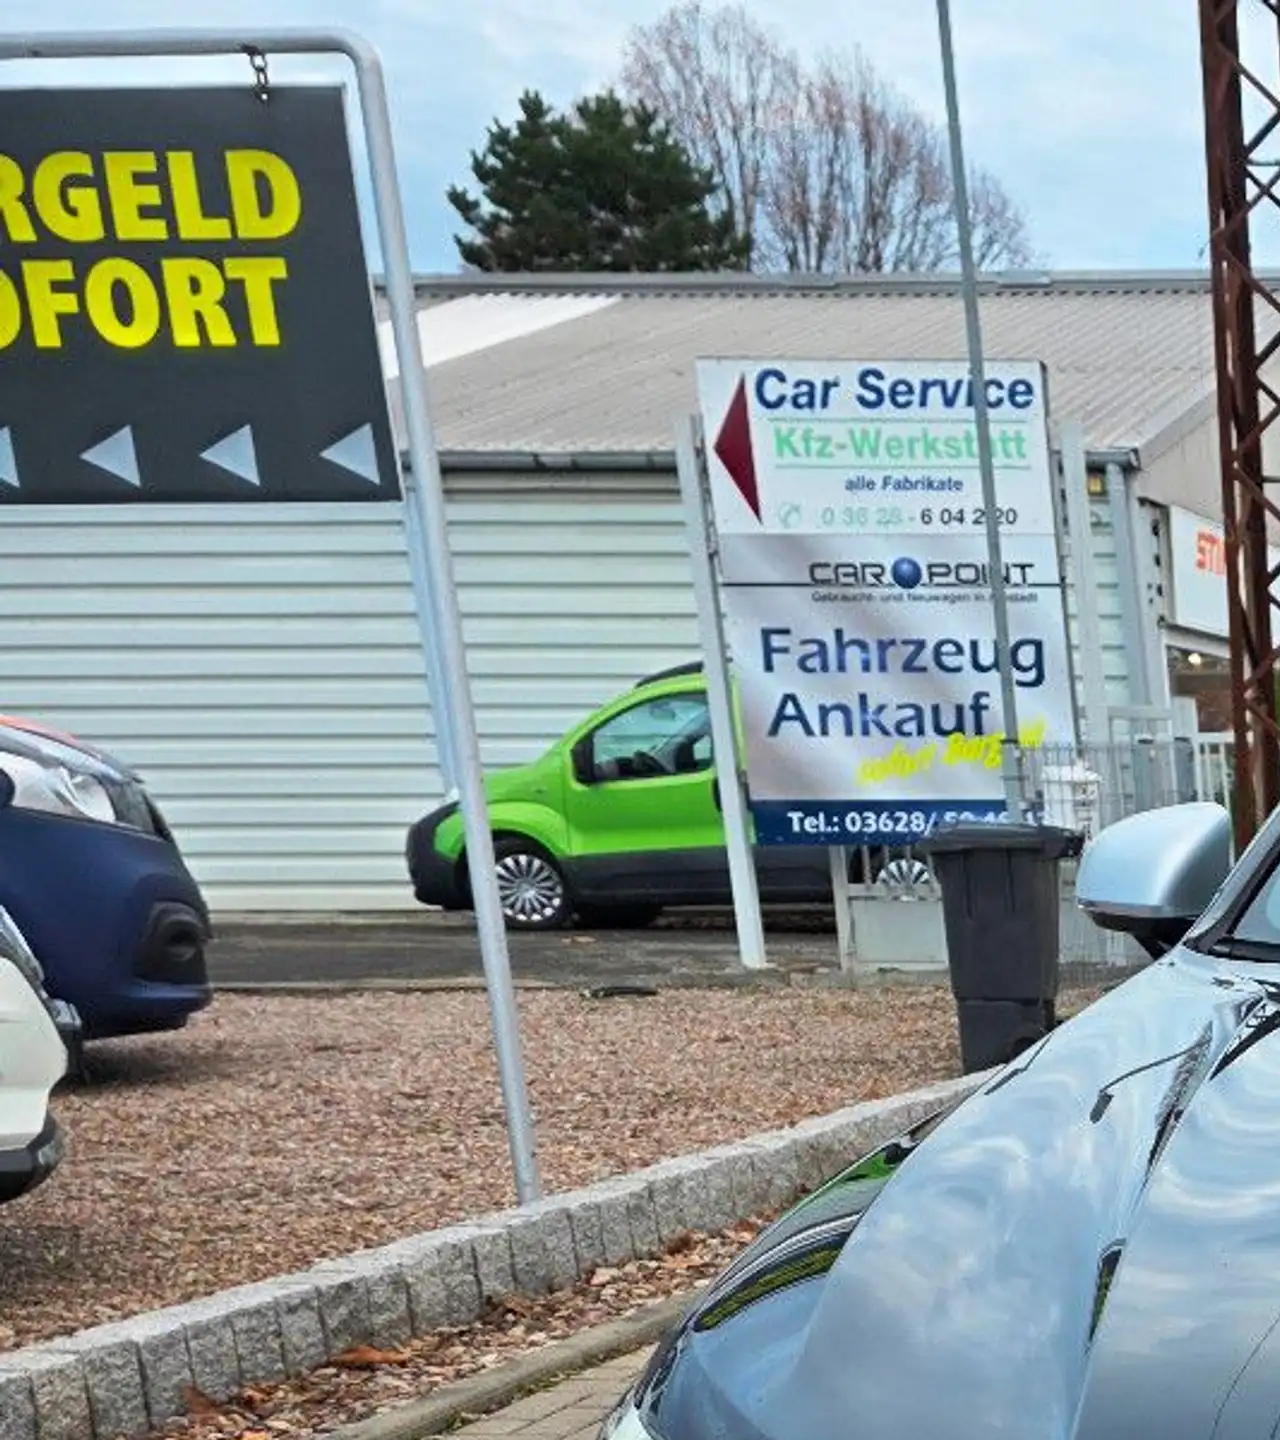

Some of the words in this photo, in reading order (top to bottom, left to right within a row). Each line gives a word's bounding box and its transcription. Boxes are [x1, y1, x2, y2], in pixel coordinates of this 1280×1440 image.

[0, 257, 288, 348] FORT
[755, 368, 840, 410] Car
[856, 368, 1034, 409] Service
[845, 476, 876, 492] alle
[882, 476, 964, 492] Fabrikate
[809, 562, 886, 584] CAR
[760, 627, 1046, 688] Fahrzeug
[767, 691, 990, 738] Ankauf
[787, 811, 840, 833] Tel.:
